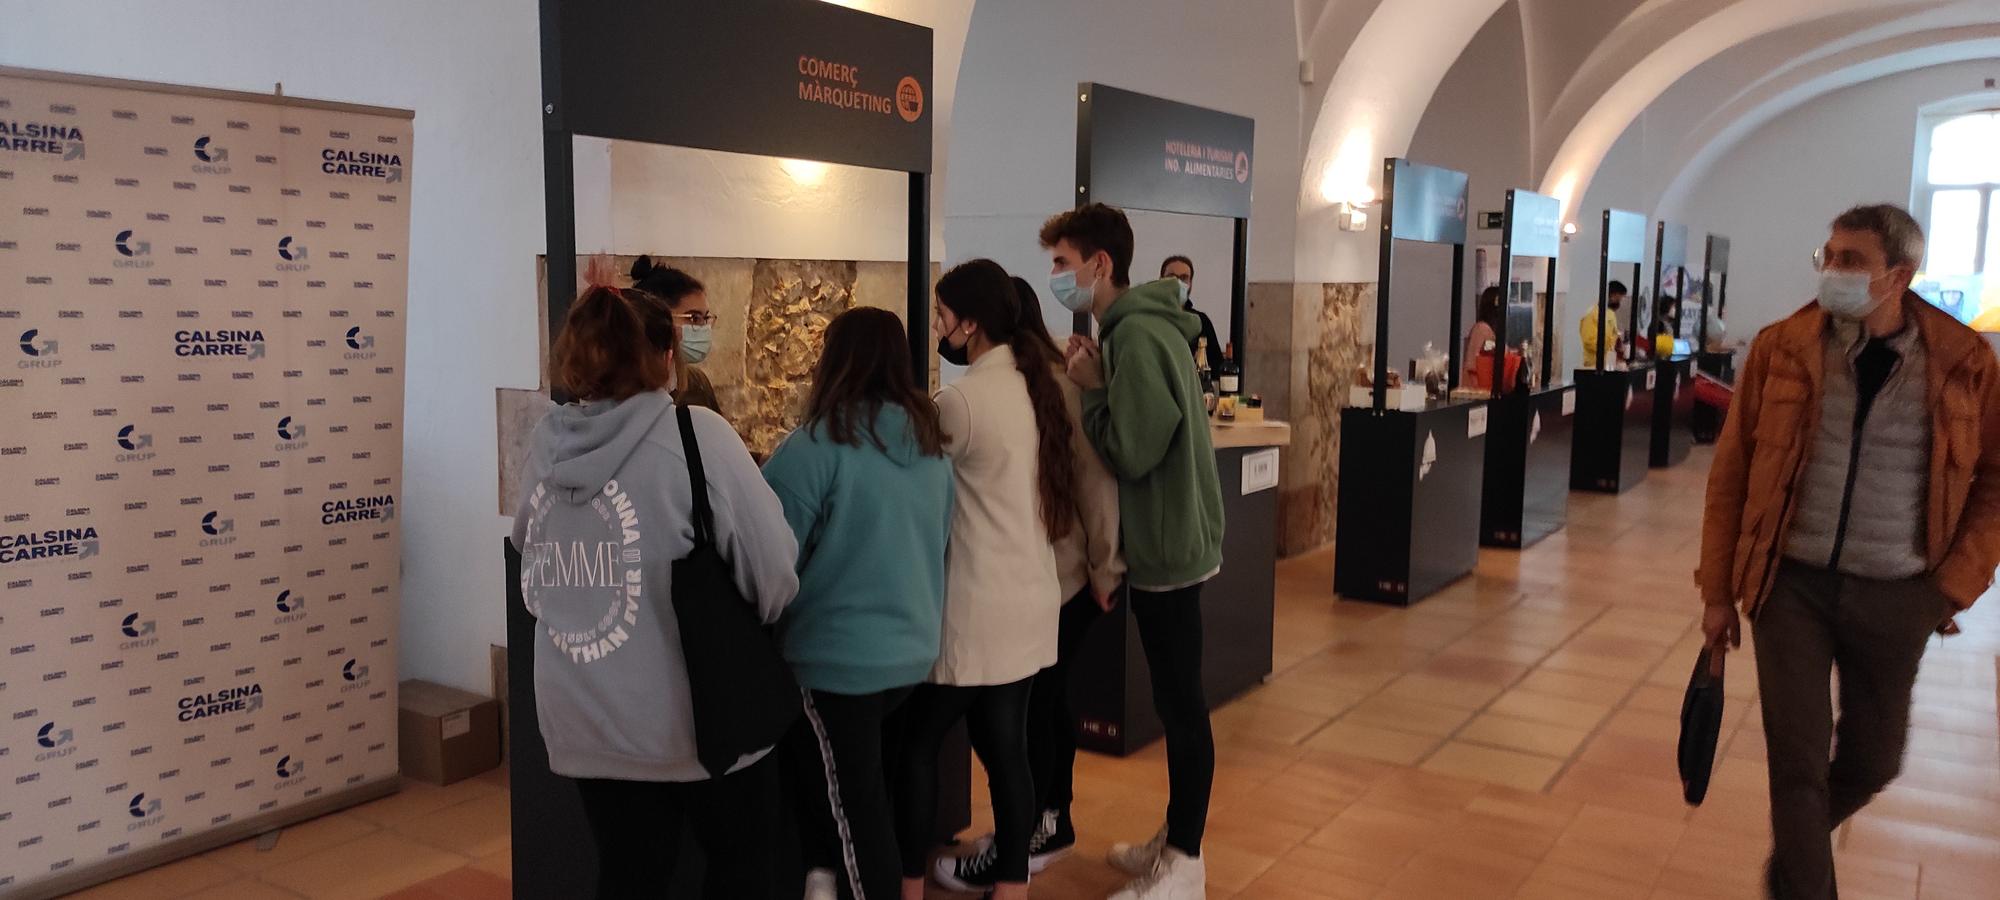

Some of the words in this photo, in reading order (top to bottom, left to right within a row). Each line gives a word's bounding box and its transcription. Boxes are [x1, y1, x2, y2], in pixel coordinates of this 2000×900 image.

[799, 56, 858, 88] COMERÇ
[799, 80, 891, 114] MÀRQUETING
[0, 122, 83, 141] ALSINA
[0, 137, 63, 154] ARRE
[322, 149, 401, 166] CALSINA
[193, 164, 232, 175] GRUP
[322, 163, 386, 178] CARRE
[113, 259, 155, 269] GRUP
[276, 263, 311, 273] GRUP
[175, 330, 265, 344] CALSINA
[175, 344, 247, 357] CARRE
[344, 352, 377, 361] GRUP
[18, 360, 62, 369] GRUP
[275, 441, 309, 451] GRUP
[116, 452, 157, 462] GRUP
[322, 495, 394, 513] CALSINA
[322, 510, 381, 526] CARRE
[603, 479, 641, 545] ONNA
[0, 527, 98, 549] CALSINA
[200, 536, 237, 547] GRUP
[0, 543, 78, 564] CARRE
[530, 541, 623, 588] FEMME
[275, 612, 307, 625] GRUP
[120, 638, 160, 650] GRUP
[568, 624, 629, 664] THAN
[178, 683, 263, 710] CALSINA
[178, 700, 247, 723] CARRE
[35, 746, 77, 761] GRUP
[128, 815, 165, 830] GRUP
